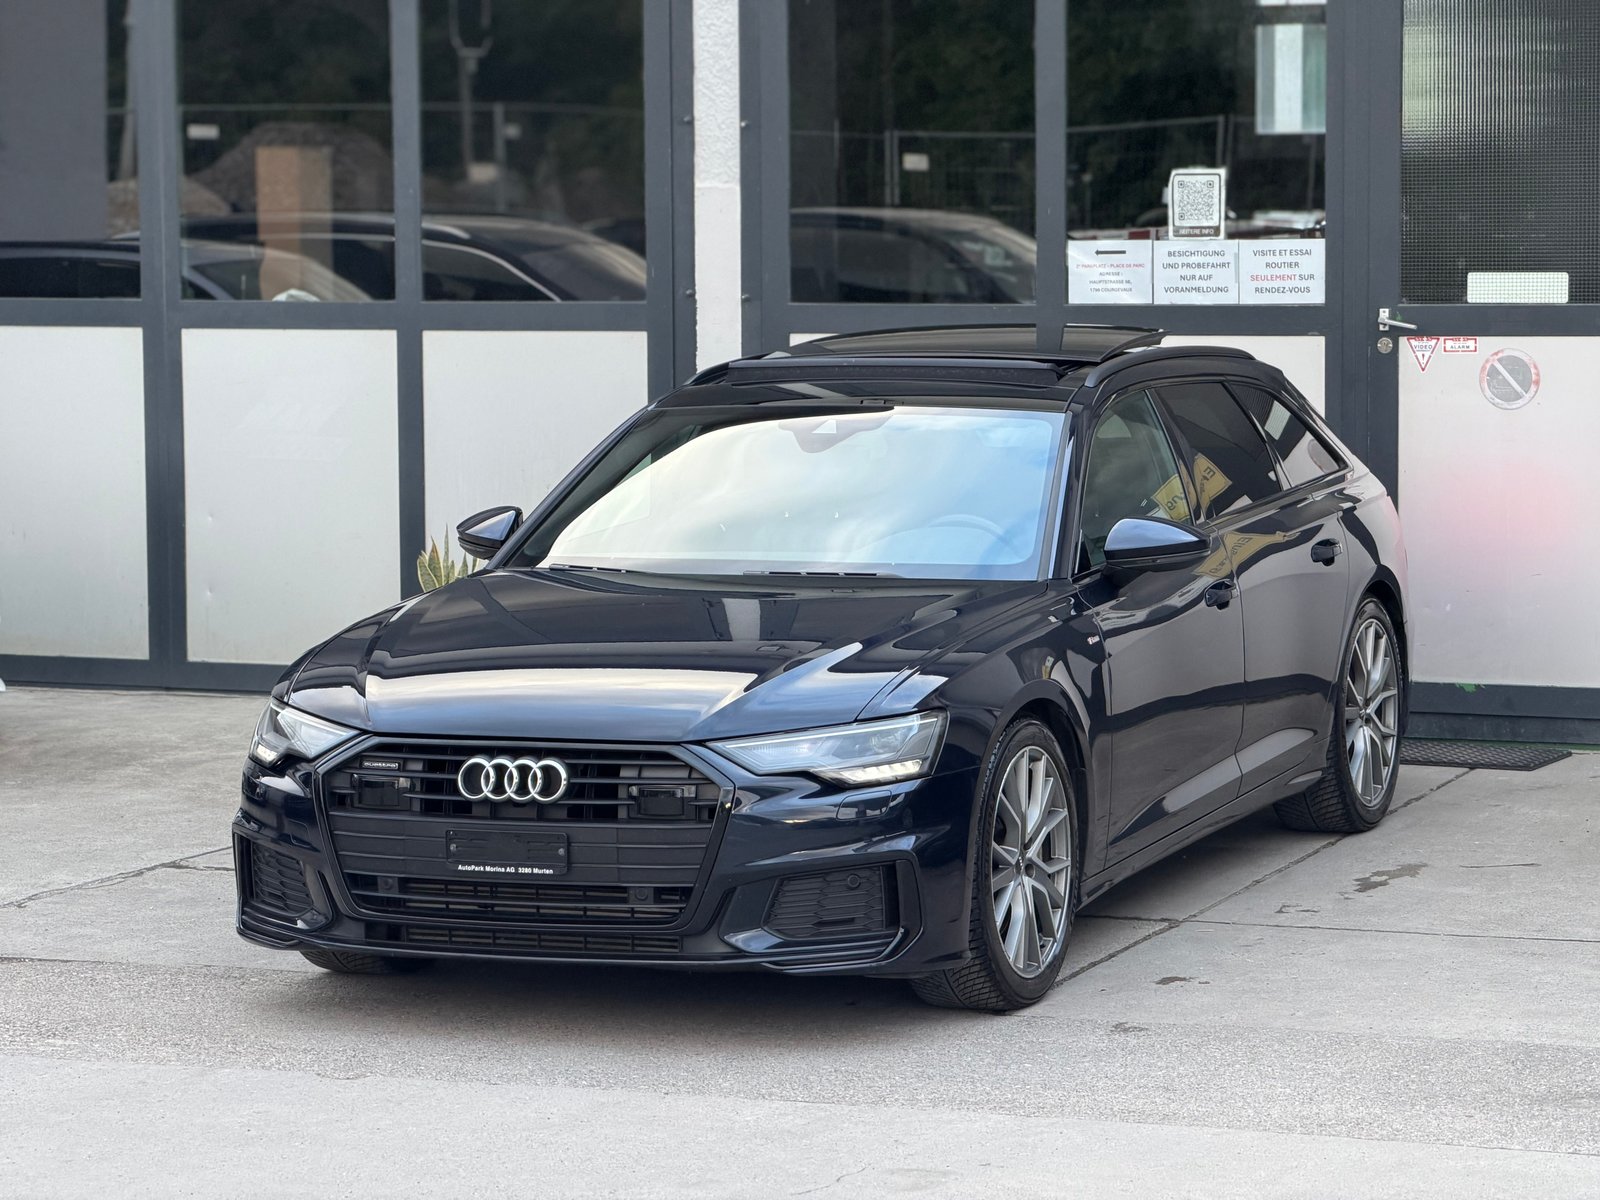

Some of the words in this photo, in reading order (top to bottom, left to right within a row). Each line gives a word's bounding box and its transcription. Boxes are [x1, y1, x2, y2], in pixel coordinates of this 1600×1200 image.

[1252, 249, 1277, 257] VISITE
[1265, 261, 1300, 269] ROUTIER
[1254, 286, 1311, 294] RENDEZ-VOUS
[457, 864, 484, 872] AutoPark
[485, 865, 505, 873] Morina
